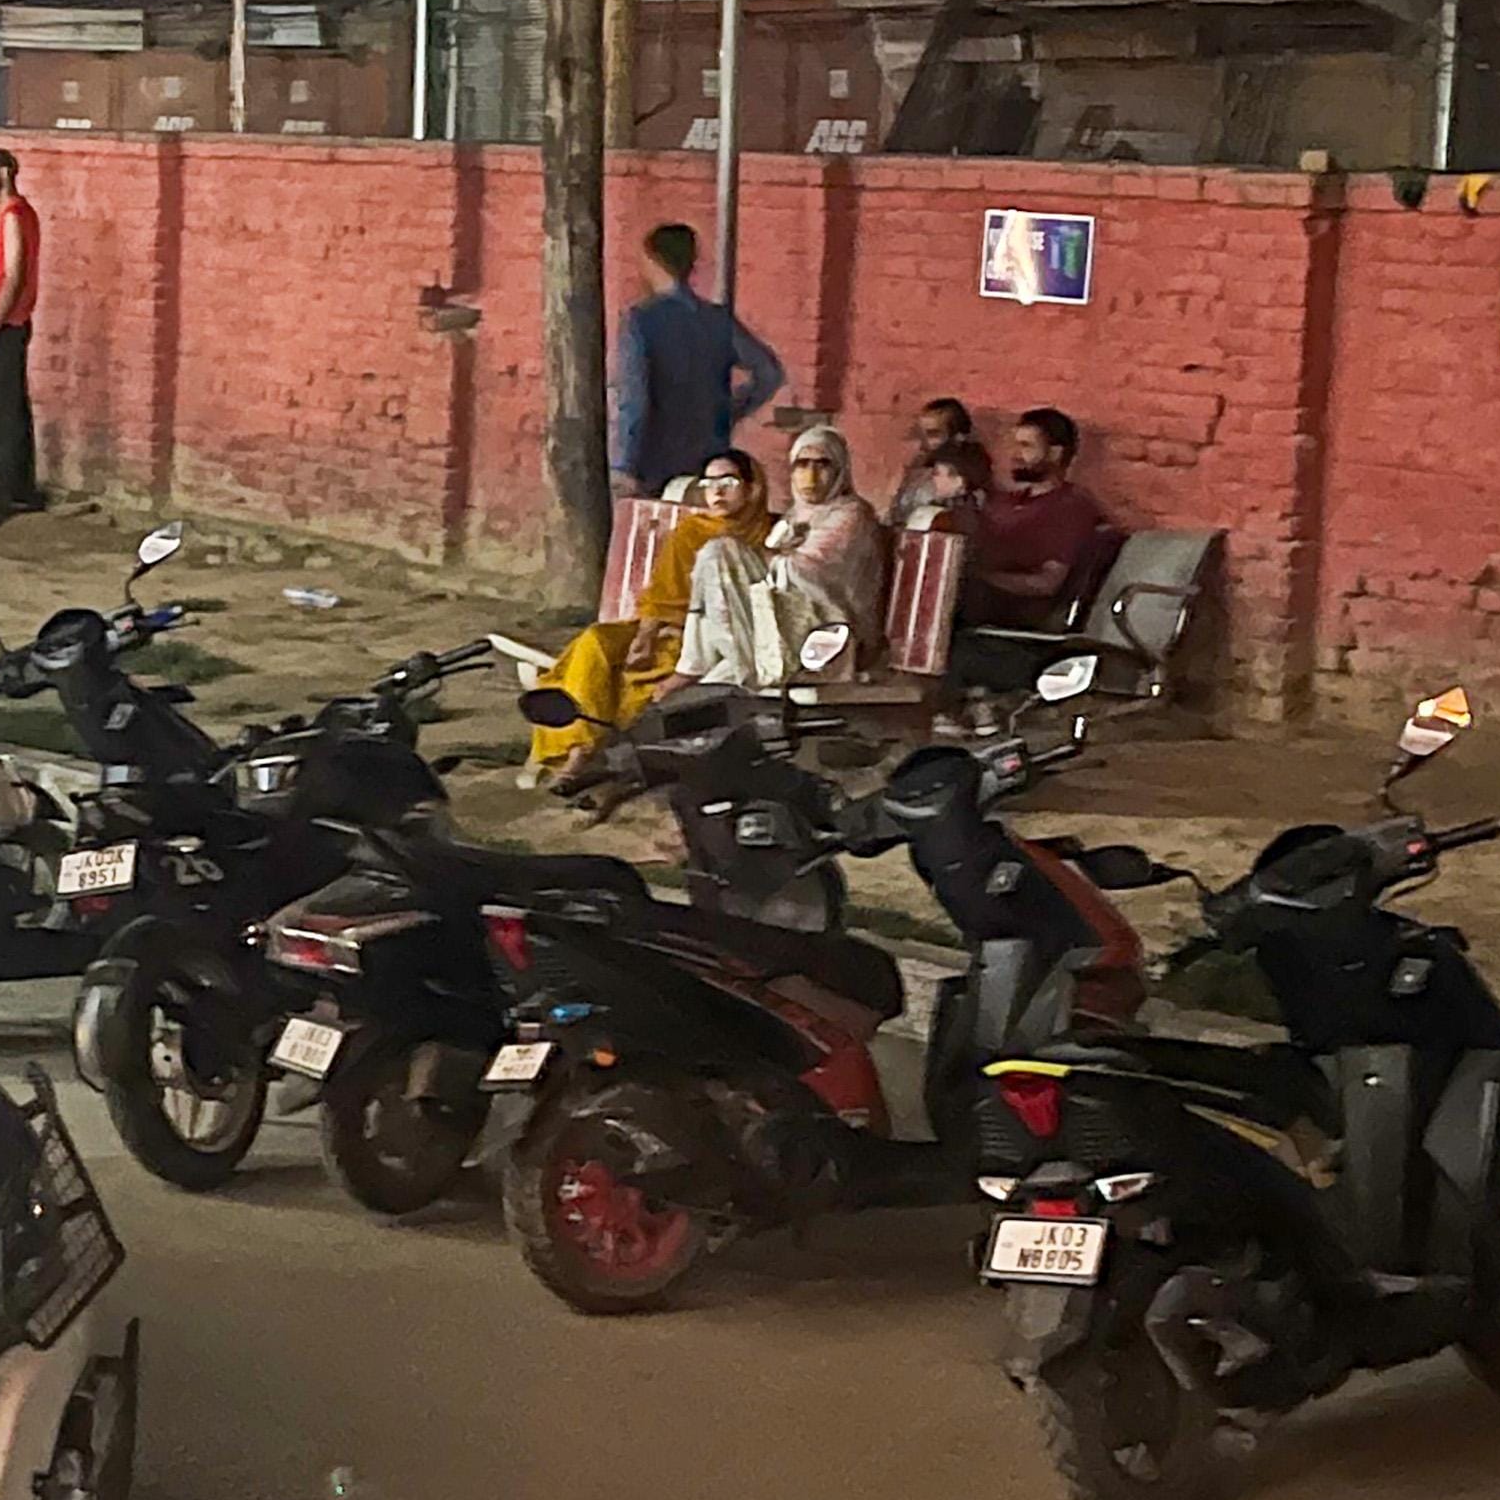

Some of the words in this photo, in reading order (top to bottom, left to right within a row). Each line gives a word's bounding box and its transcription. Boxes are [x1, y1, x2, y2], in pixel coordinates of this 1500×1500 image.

[681, 118, 721, 150] AC
[804, 119, 867, 153] ACC
[1033, 1226, 1088, 1247] JK03
